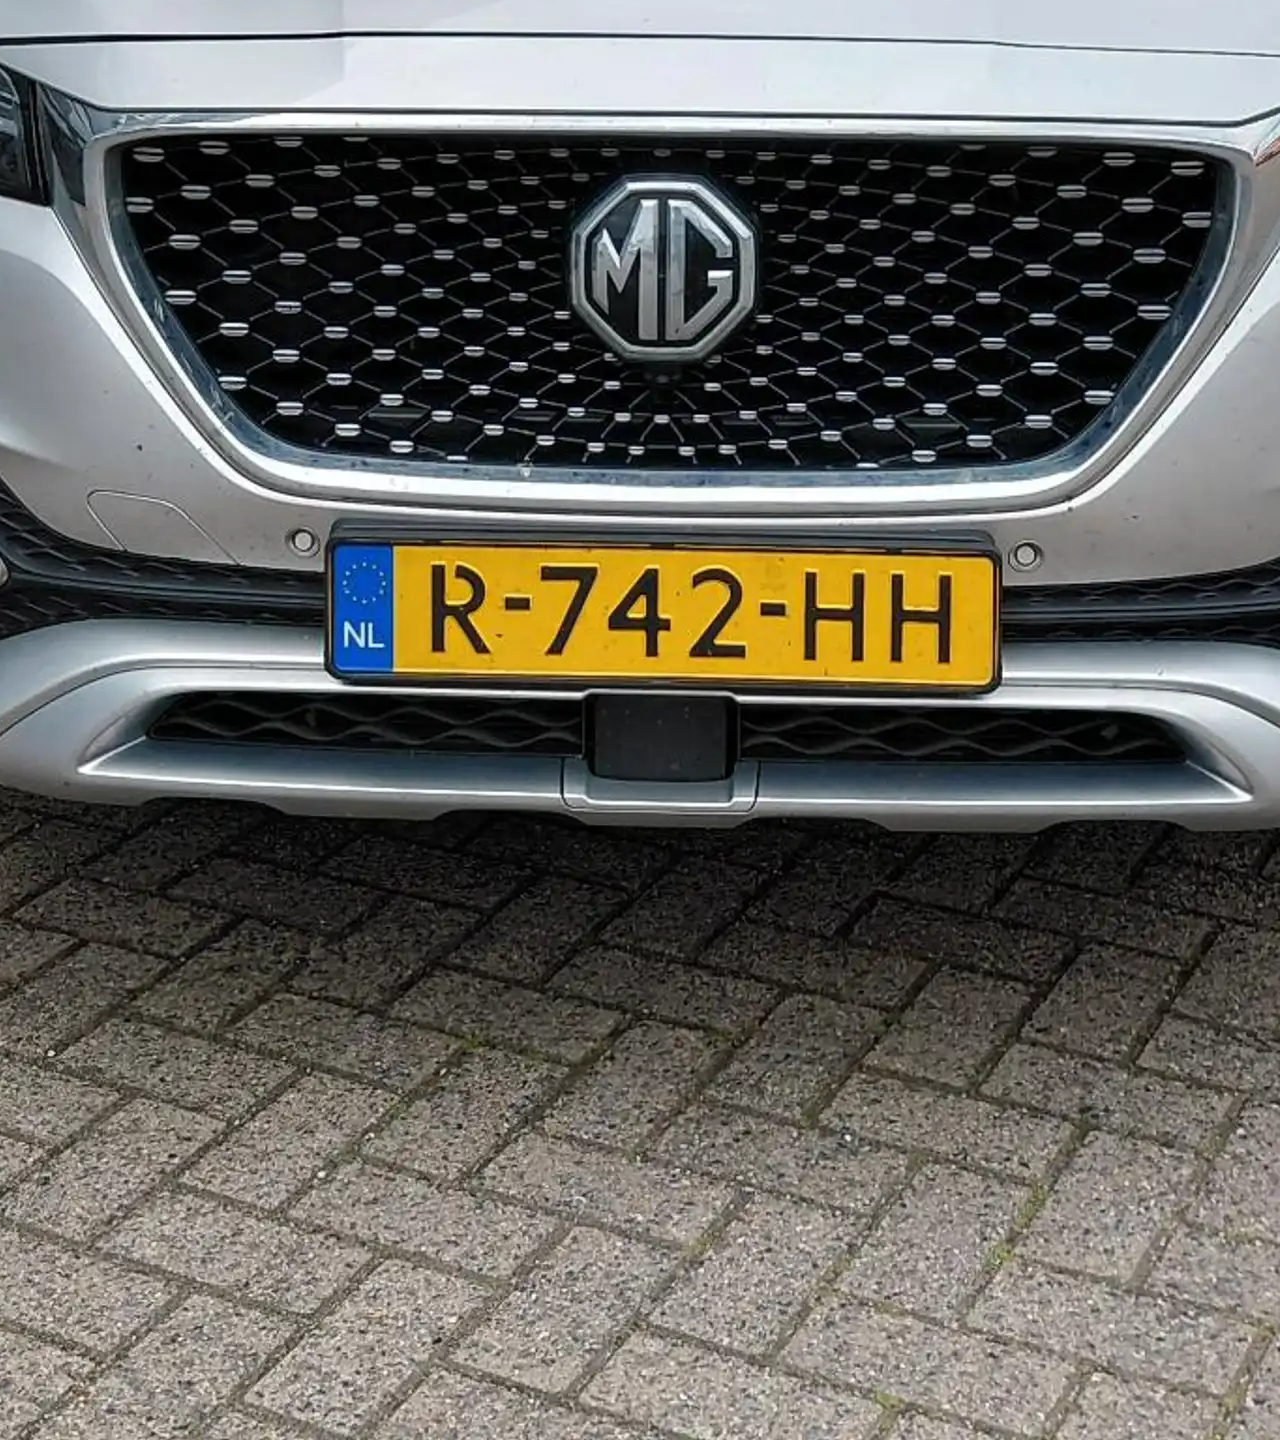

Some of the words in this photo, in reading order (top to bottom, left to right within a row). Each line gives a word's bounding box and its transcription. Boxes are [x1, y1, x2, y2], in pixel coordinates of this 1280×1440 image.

[591, 198, 734, 342] MG
[342, 620, 385, 650] NL
[430, 562, 952, 664] R-742-HH
